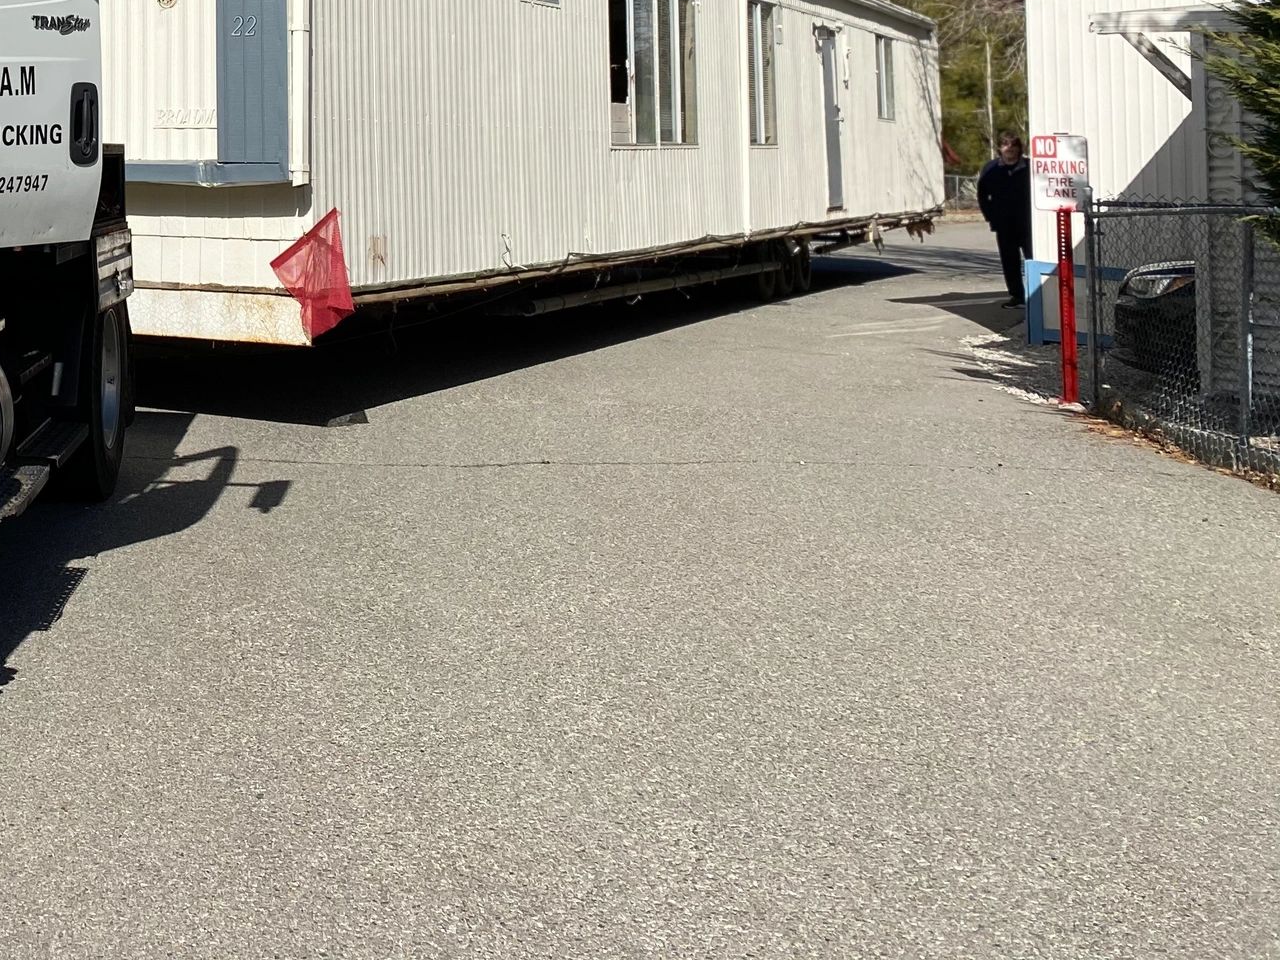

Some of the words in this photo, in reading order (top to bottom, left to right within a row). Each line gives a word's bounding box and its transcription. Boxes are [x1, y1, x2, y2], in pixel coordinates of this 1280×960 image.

[231, 15, 258, 37] 22
[1035, 138, 1055, 156] NO
[1036, 160, 1085, 175] PARKING
[1048, 177, 1074, 187] FIRE
[1046, 188, 1077, 198] LANE
